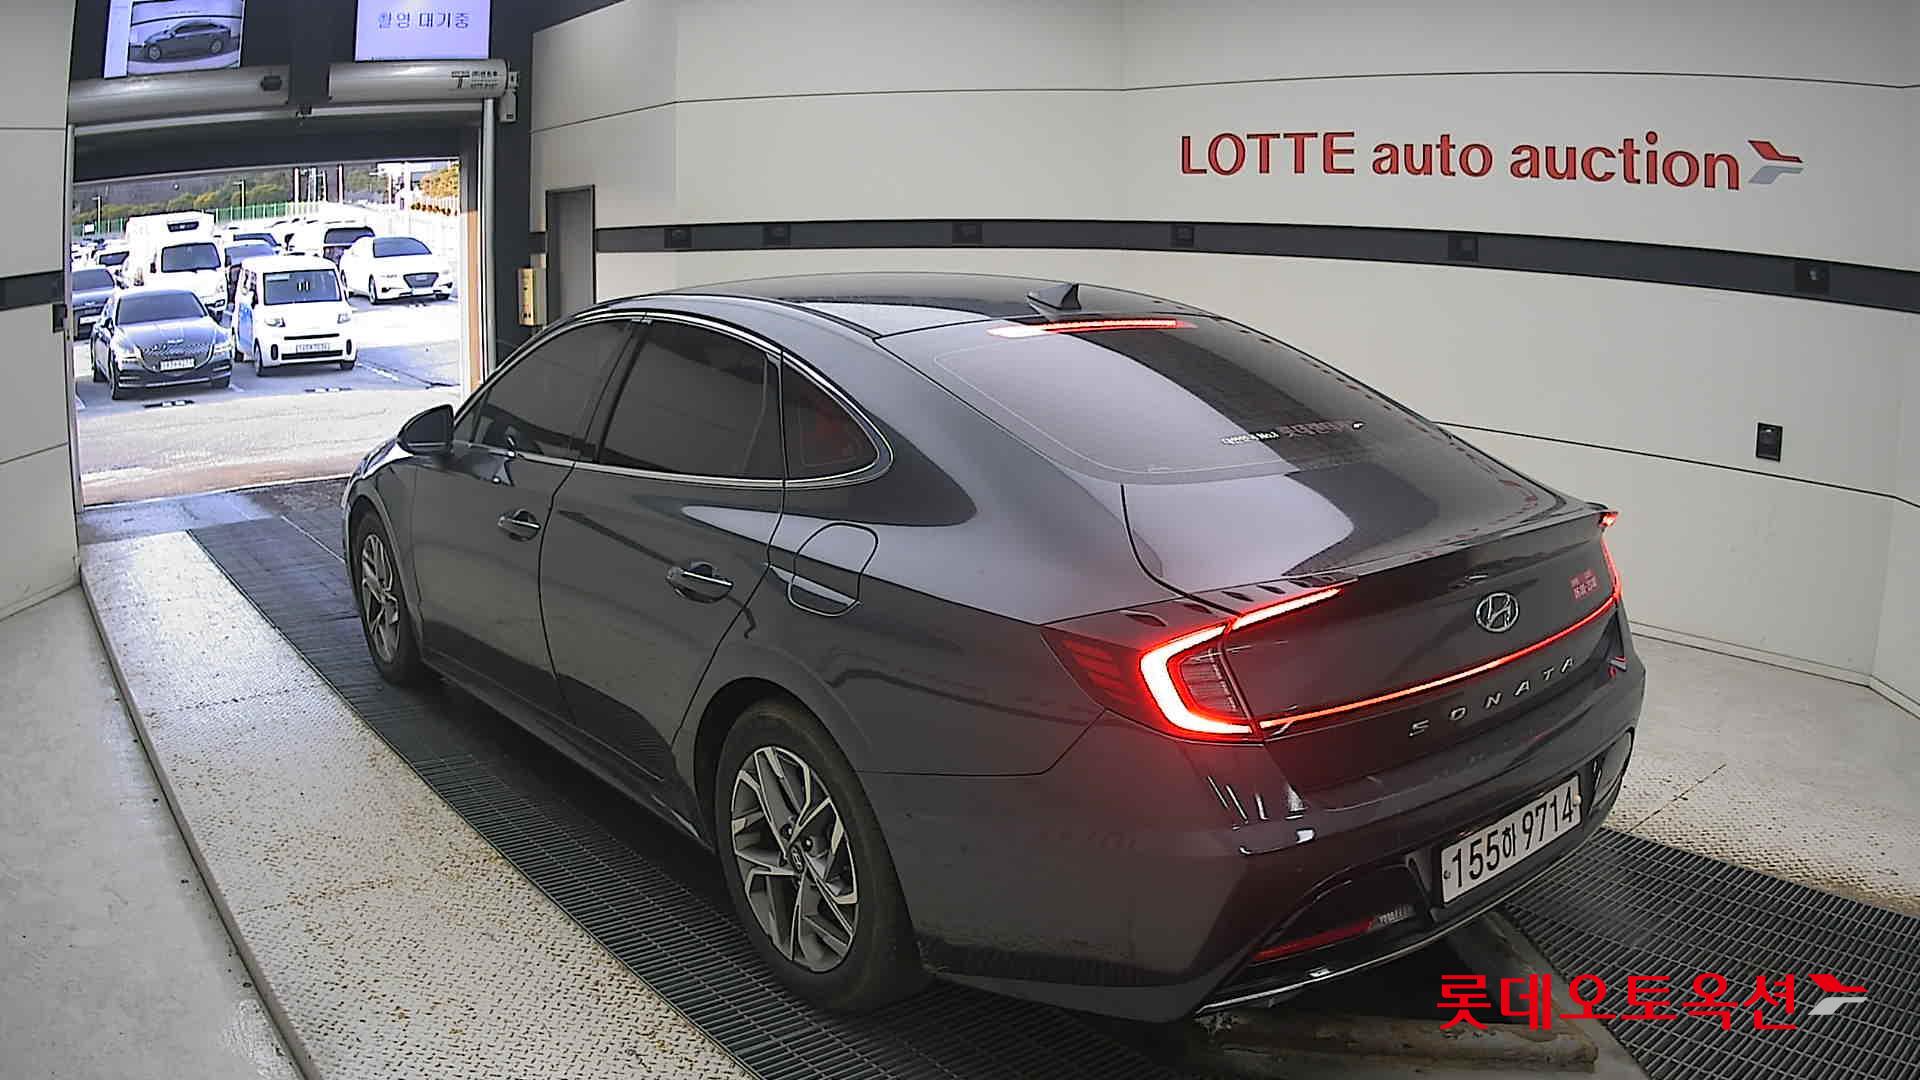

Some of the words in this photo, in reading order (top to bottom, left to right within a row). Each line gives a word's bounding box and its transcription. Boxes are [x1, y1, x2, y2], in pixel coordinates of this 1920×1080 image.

[418, 12, 469, 29] 대기중
[1181, 131, 1356, 177] LOTTE
[1371, 133, 1494, 177] auto
[1510, 130, 1741, 191] auction
[1409, 656, 1575, 737] SONATA
[1521, 786, 1578, 850] 9714
